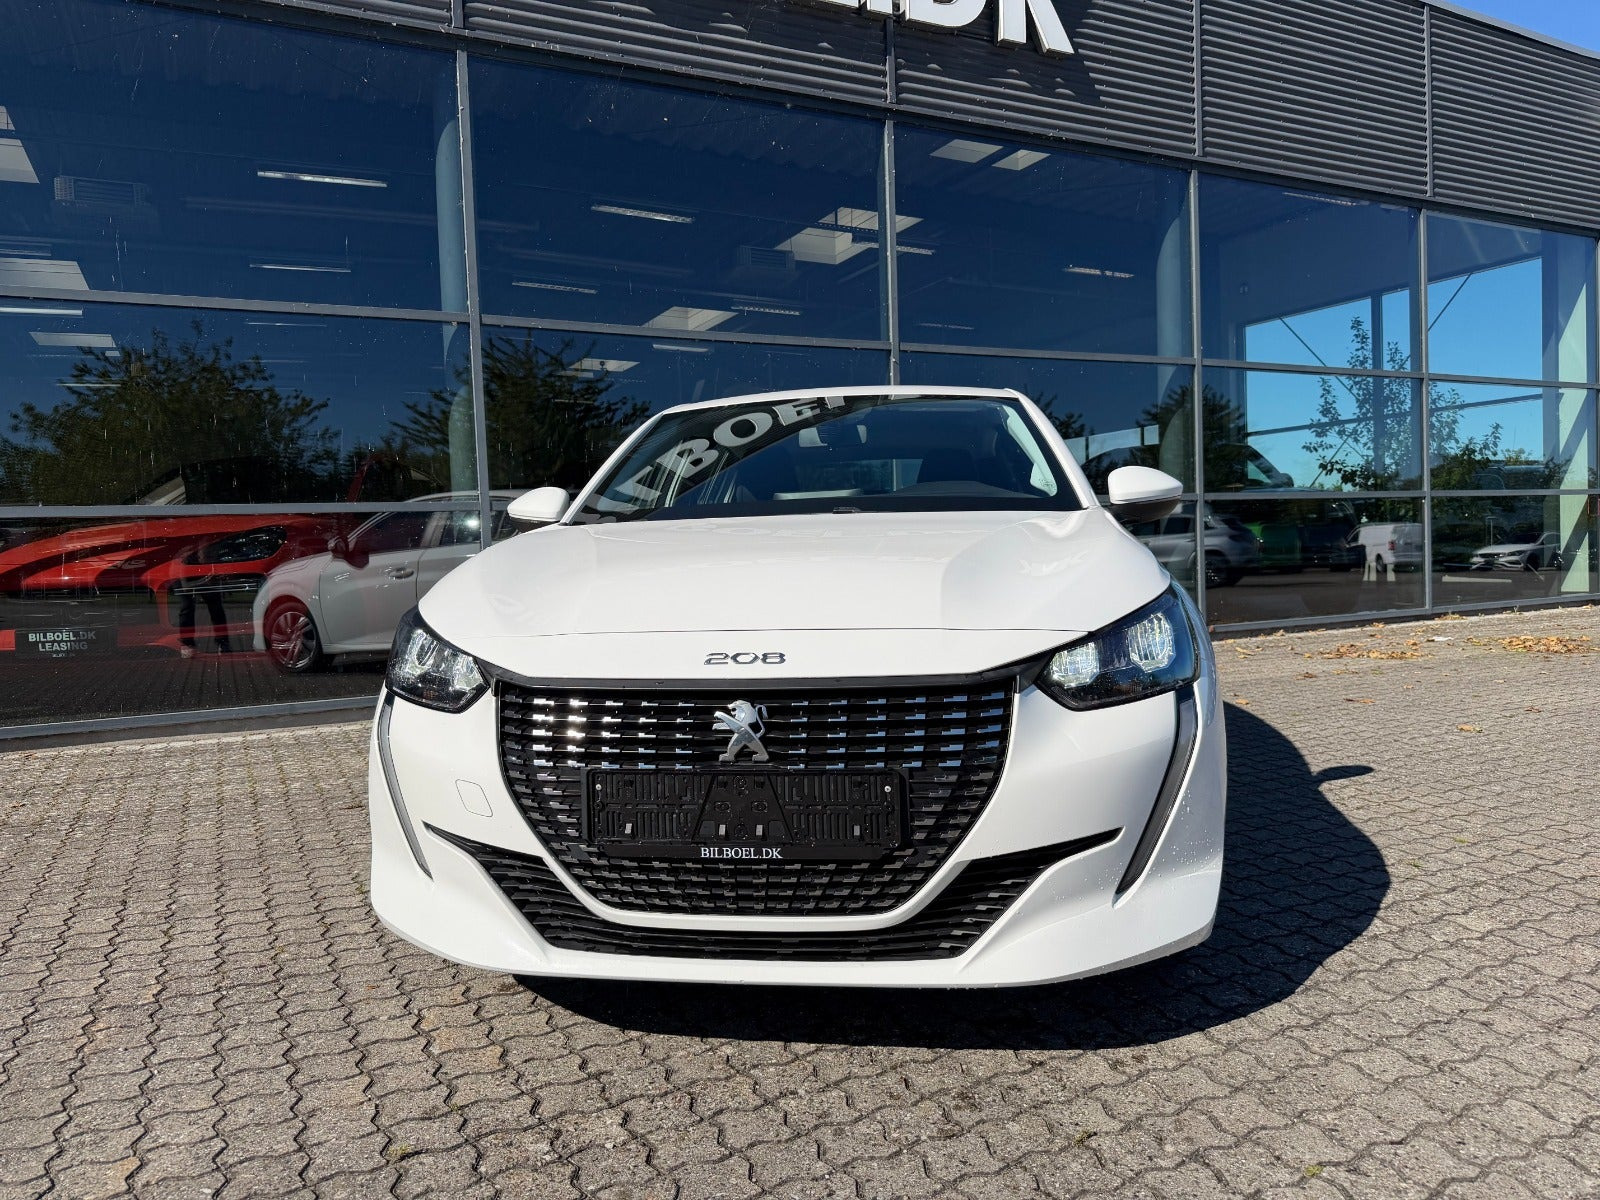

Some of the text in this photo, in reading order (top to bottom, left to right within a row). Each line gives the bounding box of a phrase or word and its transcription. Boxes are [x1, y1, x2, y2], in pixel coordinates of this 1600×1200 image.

[28, 631, 96, 642] BILBOEL.DK
[38, 641, 88, 652] LEASING
[703, 652, 786, 665] 208
[700, 847, 783, 859] BILBOEL.DK
